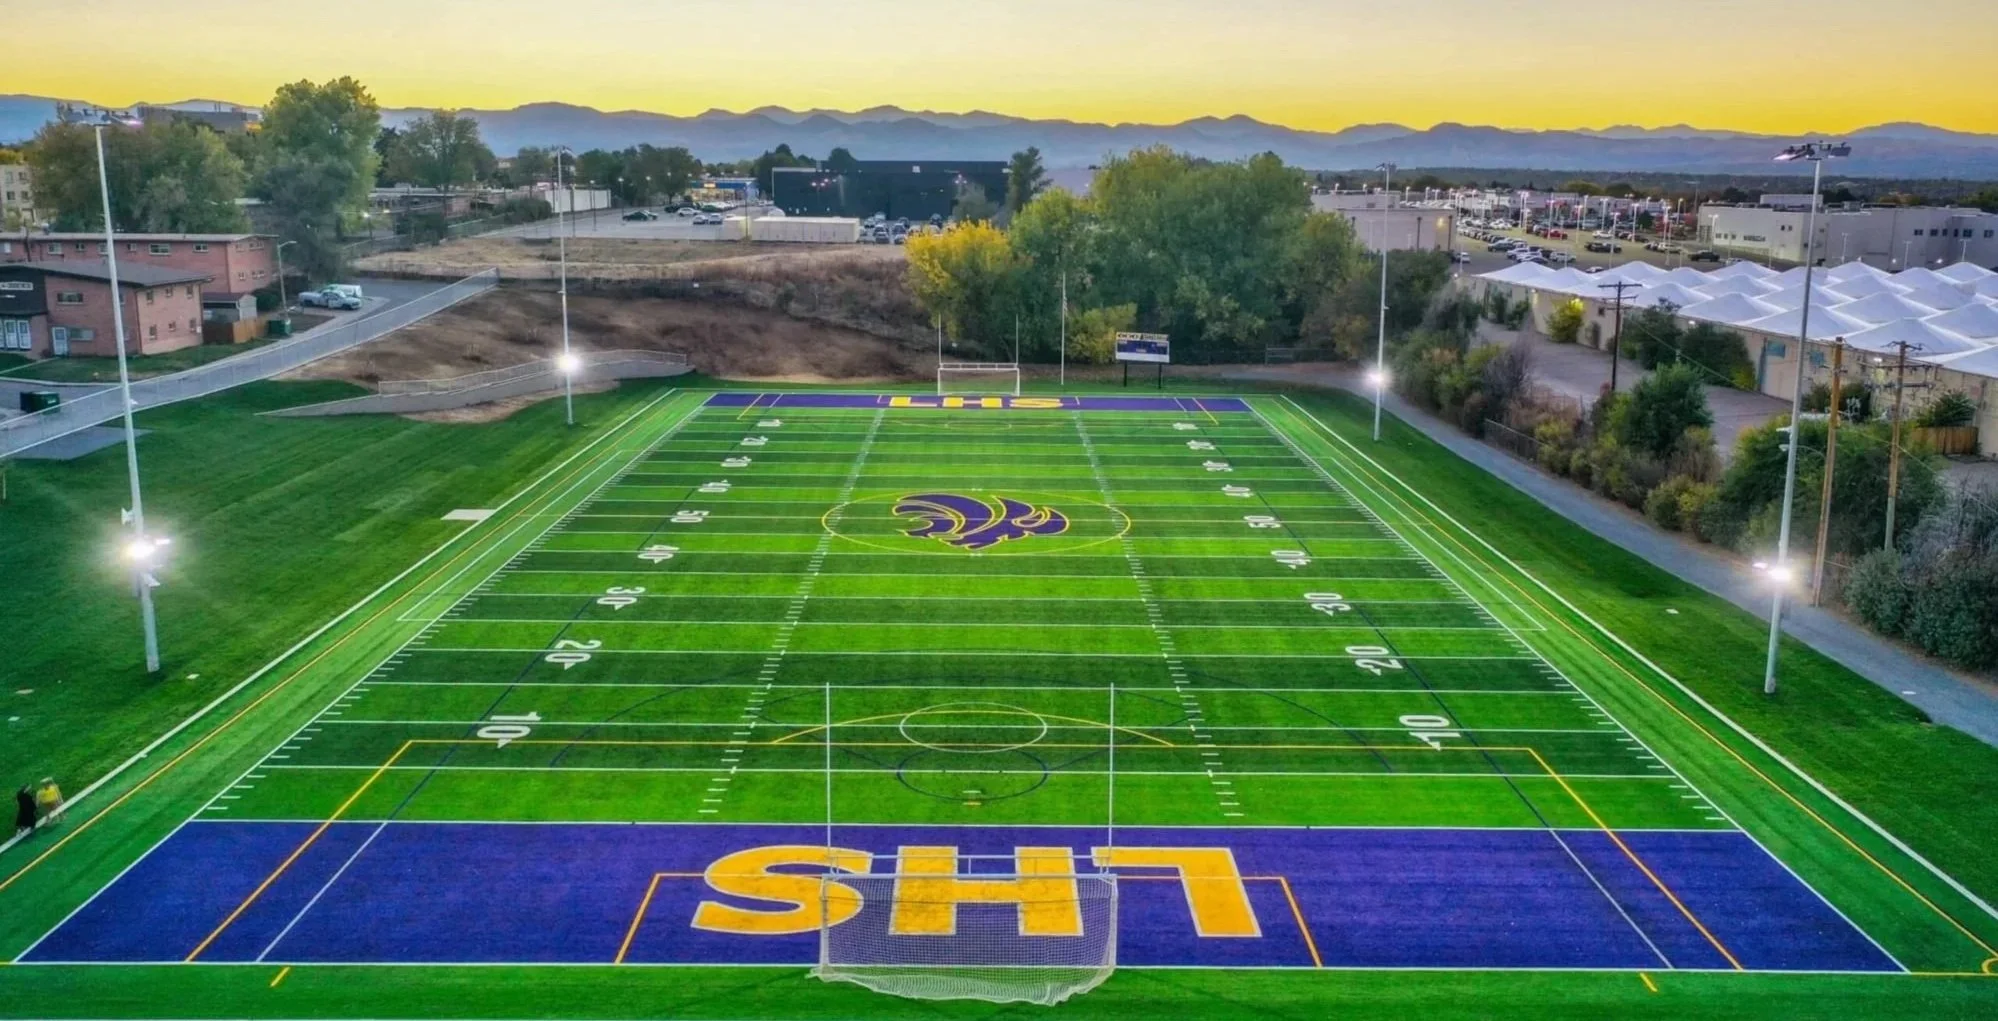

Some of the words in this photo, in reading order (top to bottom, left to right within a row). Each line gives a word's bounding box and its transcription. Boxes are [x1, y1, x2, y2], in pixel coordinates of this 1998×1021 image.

[889, 396, 1064, 408] LHS
[670, 510, 710, 523] 50
[638, 545, 679, 561] 40
[596, 586, 646, 606] 30
[1303, 592, 1352, 613] 30
[545, 640, 602, 663] 20
[1345, 646, 1403, 671] 20
[477, 711, 542, 739] 10
[1399, 714, 1461, 740] 10
[691, 845, 1263, 937] LHS
